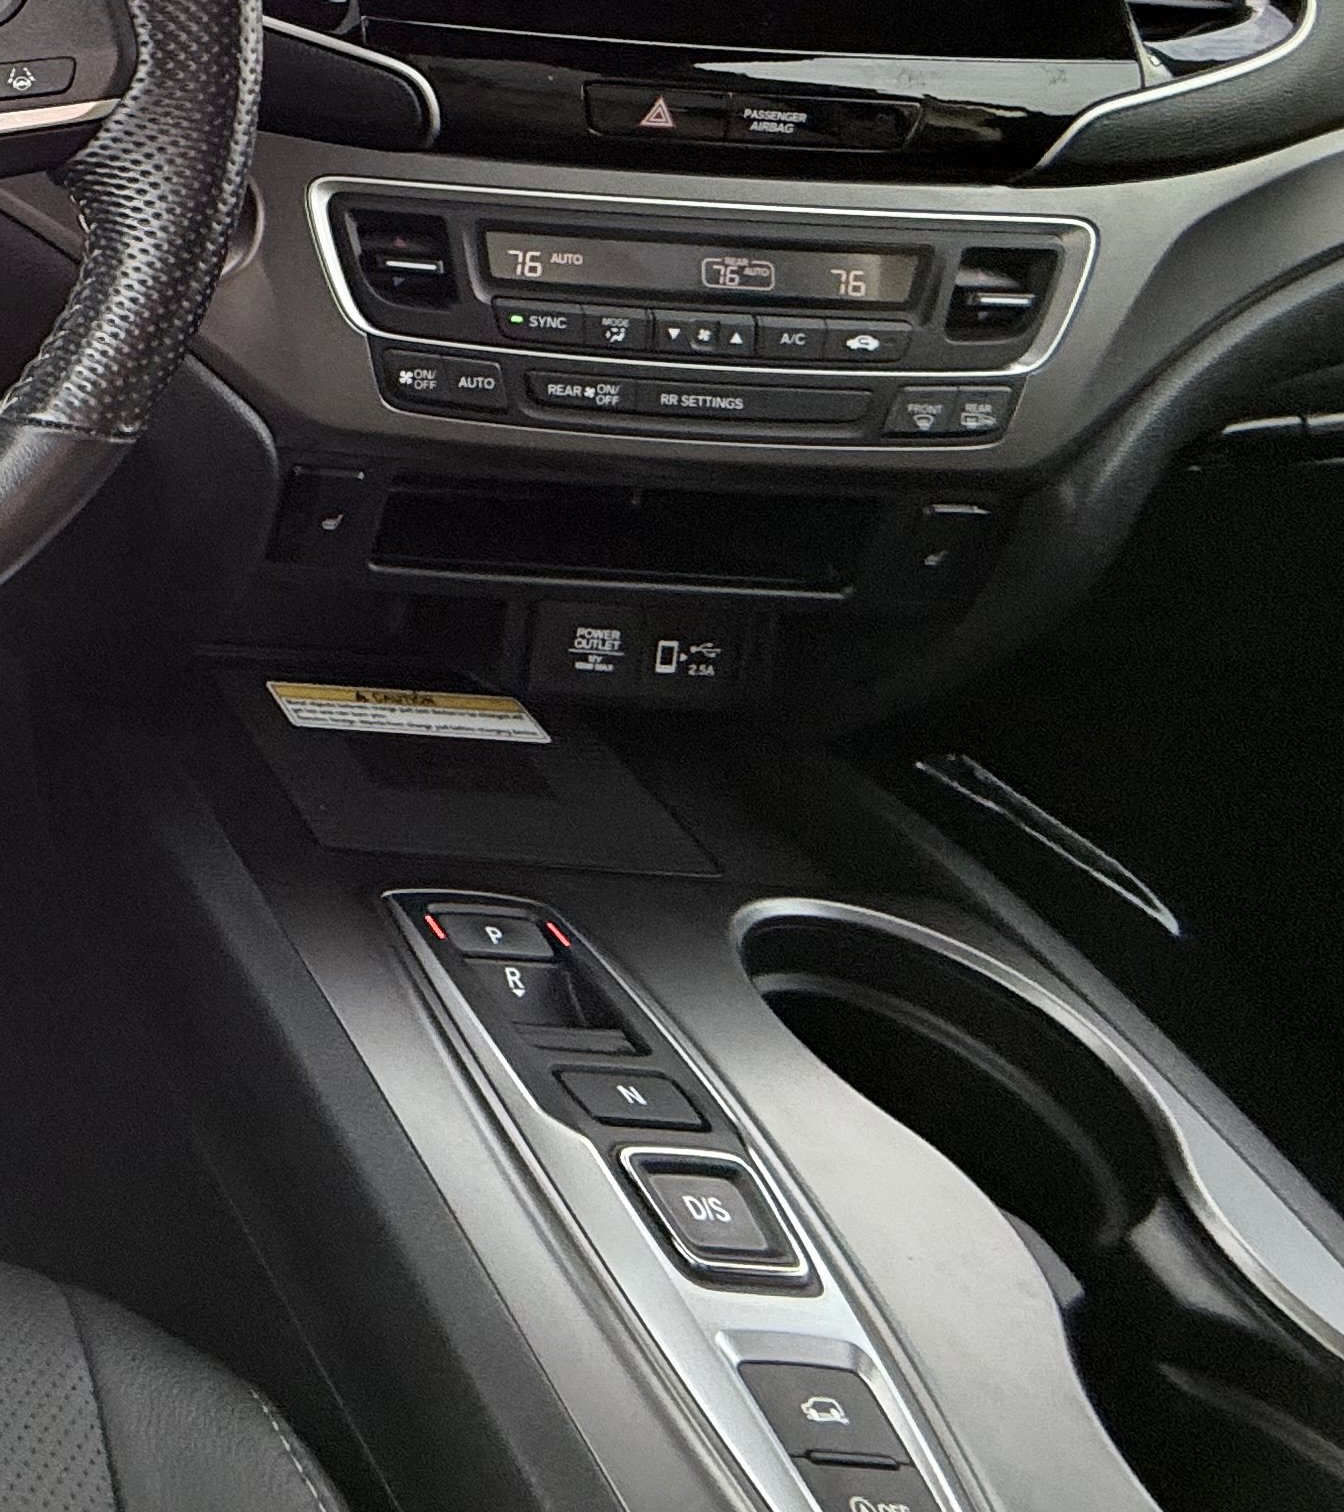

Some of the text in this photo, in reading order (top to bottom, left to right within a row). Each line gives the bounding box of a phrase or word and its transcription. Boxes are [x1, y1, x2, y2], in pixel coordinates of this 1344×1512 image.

[743, 108, 808, 123] PASSENGER
[749, 121, 795, 134] AIRBAG
[506, 249, 584, 278] 76 AUTO
[711, 265, 770, 286] 76 AUTO
[830, 268, 867, 297] 76
[528, 315, 568, 329] SYNC
[601, 317, 630, 327] MODE
[779, 332, 807, 347] A/C
[414, 369, 437, 380] ON/
[414, 379, 438, 390] OFF
[458, 376, 496, 389] AUTO
[596, 383, 621, 395] ON/
[547, 383, 582, 398] REAR
[595, 394, 621, 406] OFF
[660, 393, 744, 410] RR SETTINGS
[907, 403, 943, 415] FRONT
[964, 402, 993, 414] REAR
[576, 626, 621, 640] POWER
[574, 638, 622, 651] OUTLET
[687, 662, 715, 676] 2.5A
[484, 925, 504, 945] P
[504, 966, 525, 990] R
[616, 1084, 648, 1106] N
[682, 1194, 732, 1224] D/S
